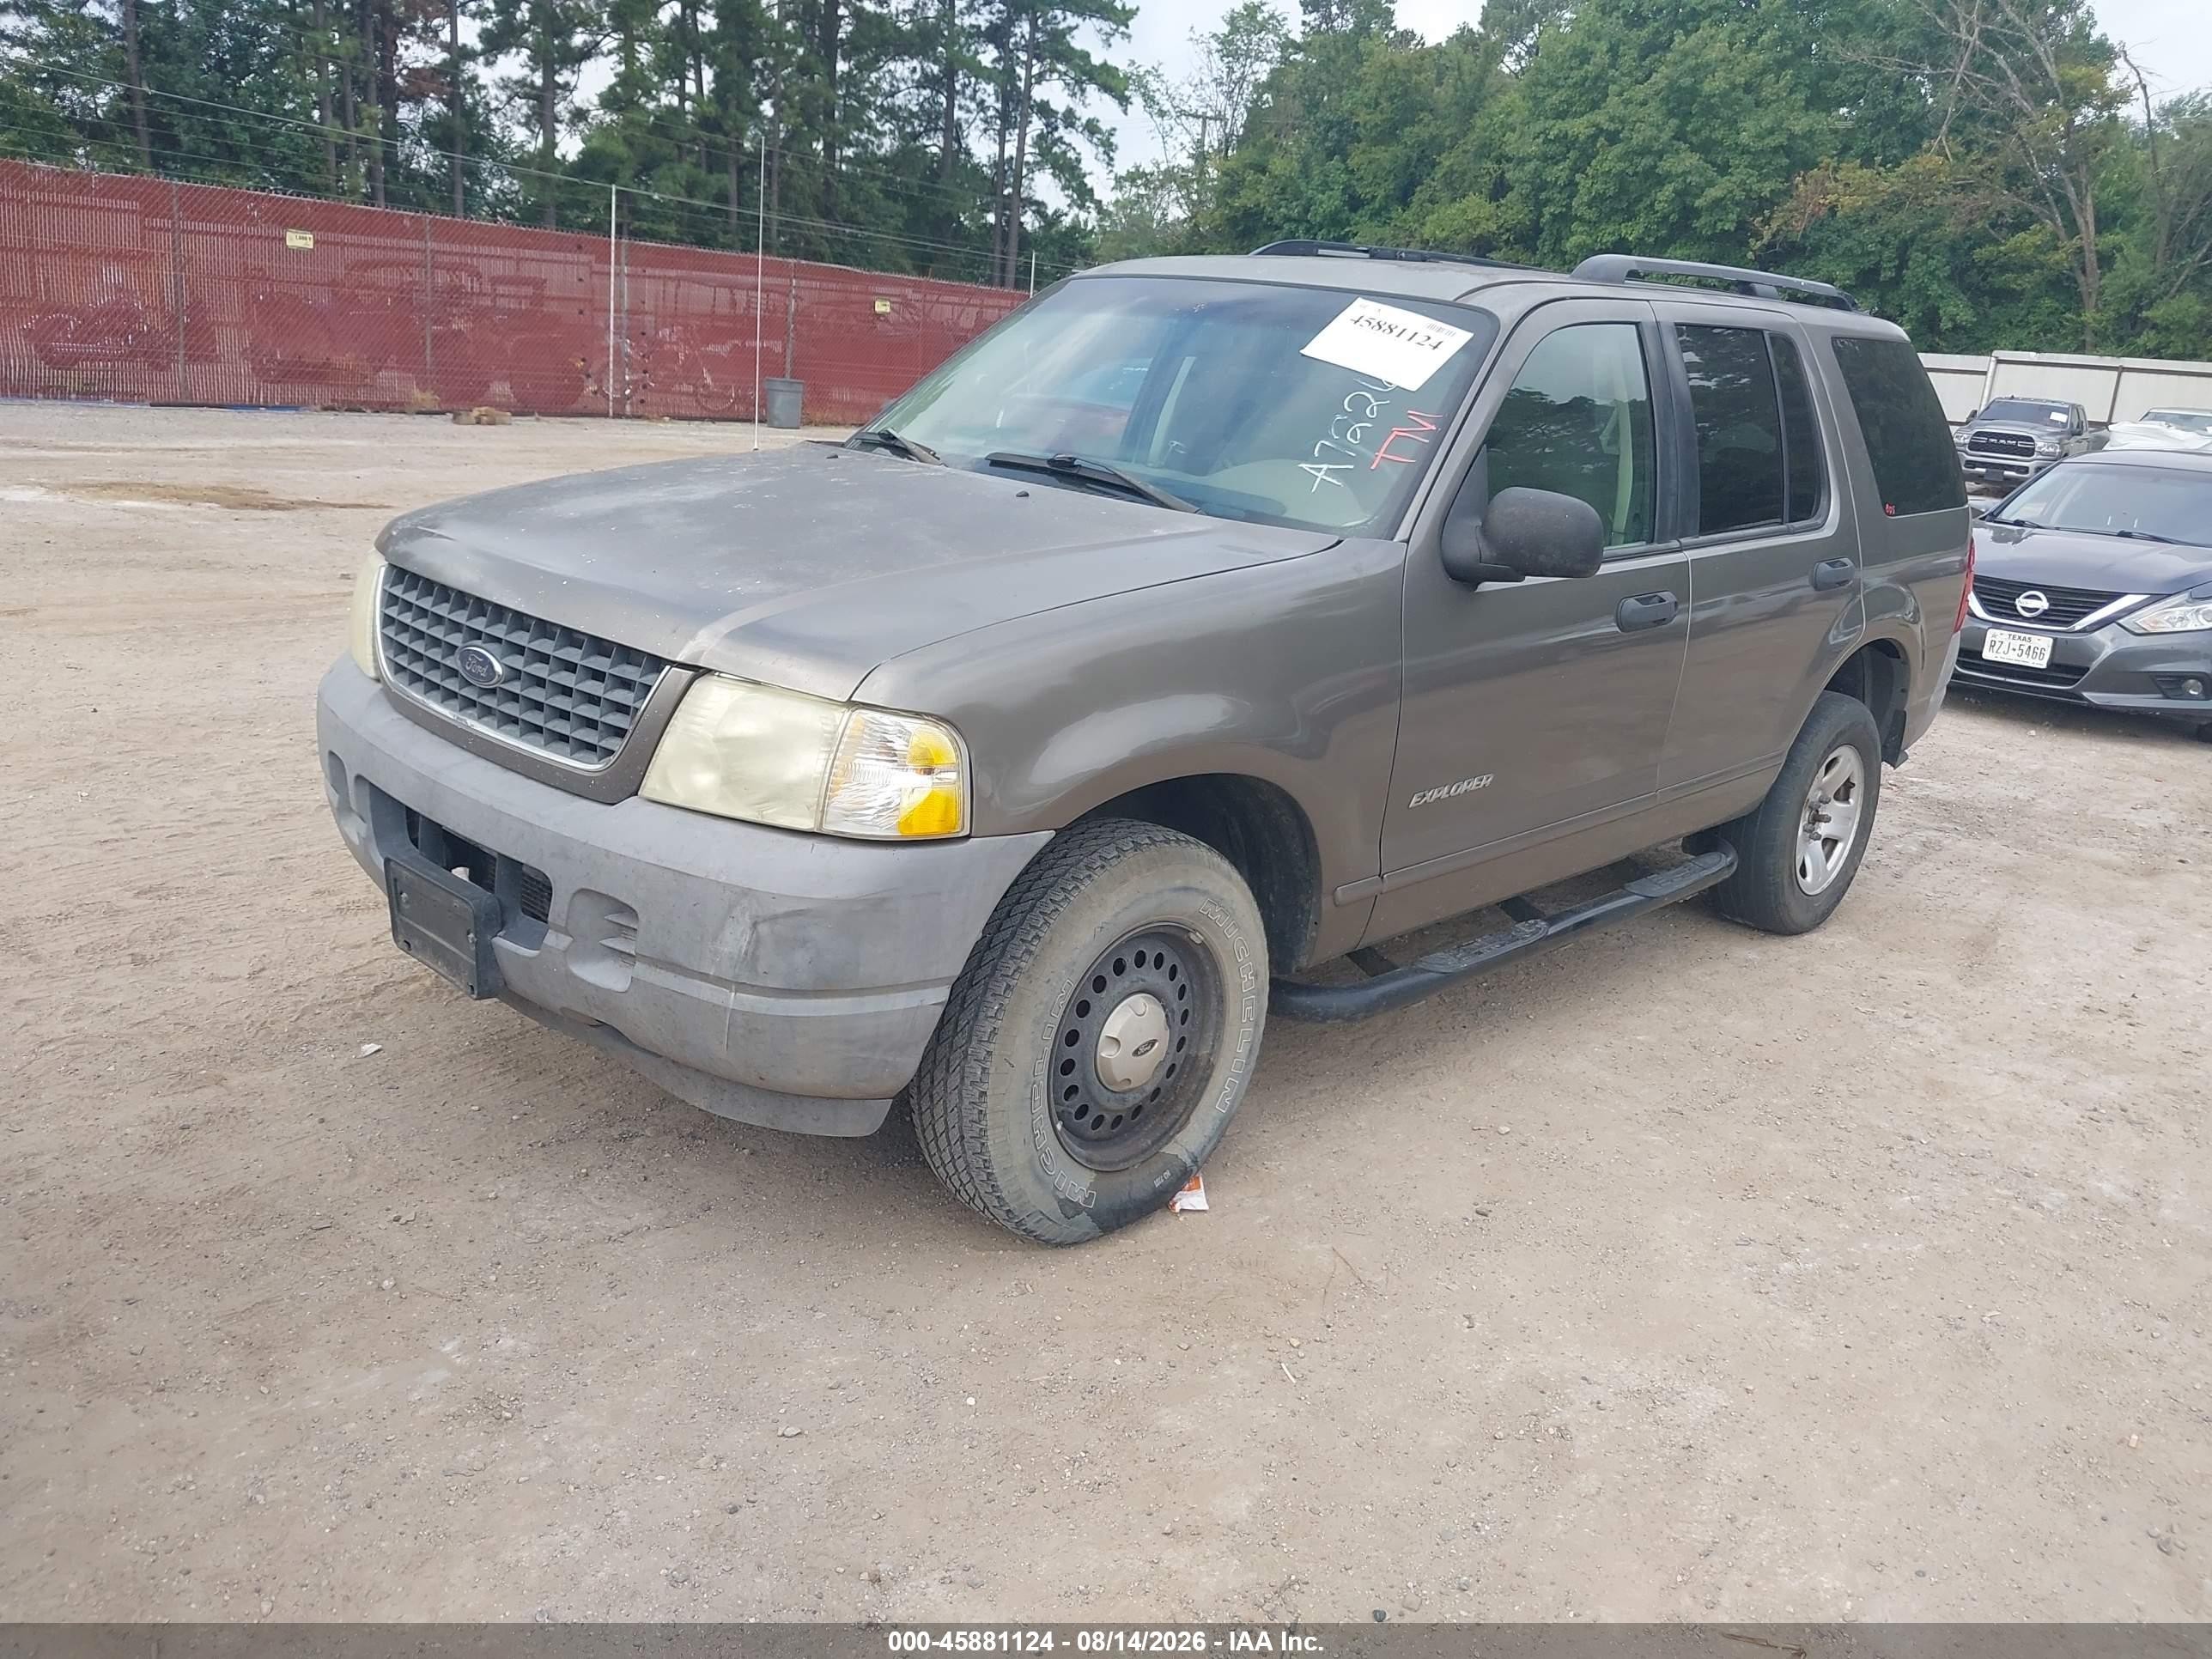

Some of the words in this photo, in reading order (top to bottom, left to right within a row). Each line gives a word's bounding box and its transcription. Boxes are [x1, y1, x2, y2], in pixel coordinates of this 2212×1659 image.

[1349, 314, 1443, 350] 45881124
[2008, 634, 2033, 643] TEXAS
[1408, 773, 1494, 808] EXPLORER
[1199, 897, 1256, 1114] MICHELIN
[1030, 979, 1097, 1209] MICHELIN
